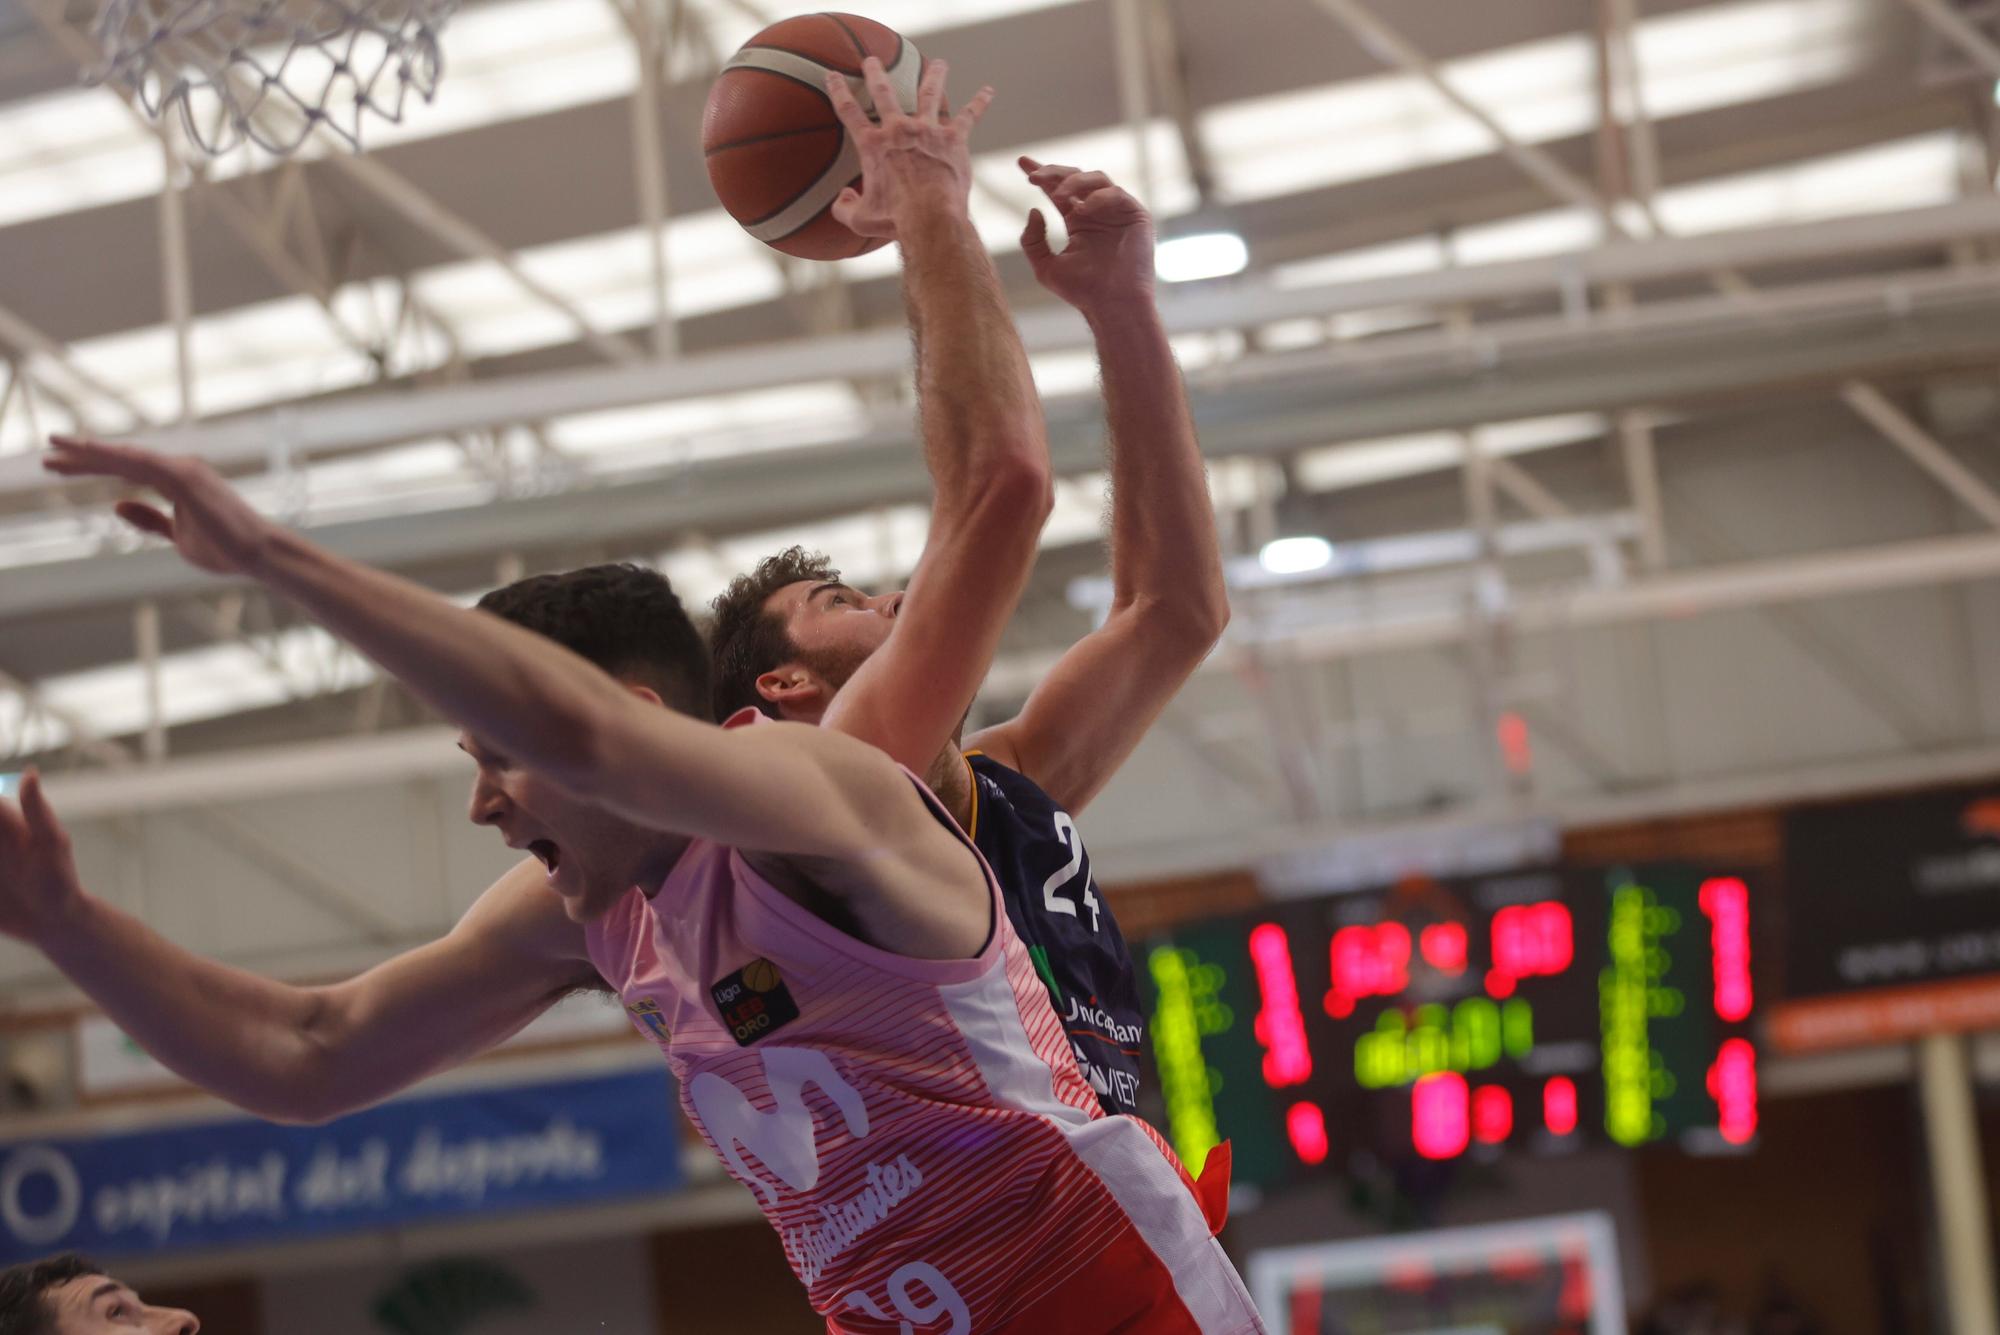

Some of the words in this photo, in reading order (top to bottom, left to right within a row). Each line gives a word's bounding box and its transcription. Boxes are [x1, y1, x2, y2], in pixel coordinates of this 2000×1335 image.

[1043, 811, 1100, 933] 24
[715, 983, 741, 1004] Liga
[735, 1013, 770, 1040] ORO
[298, 1138, 389, 1211] del
[405, 1120, 600, 1200] deporte
